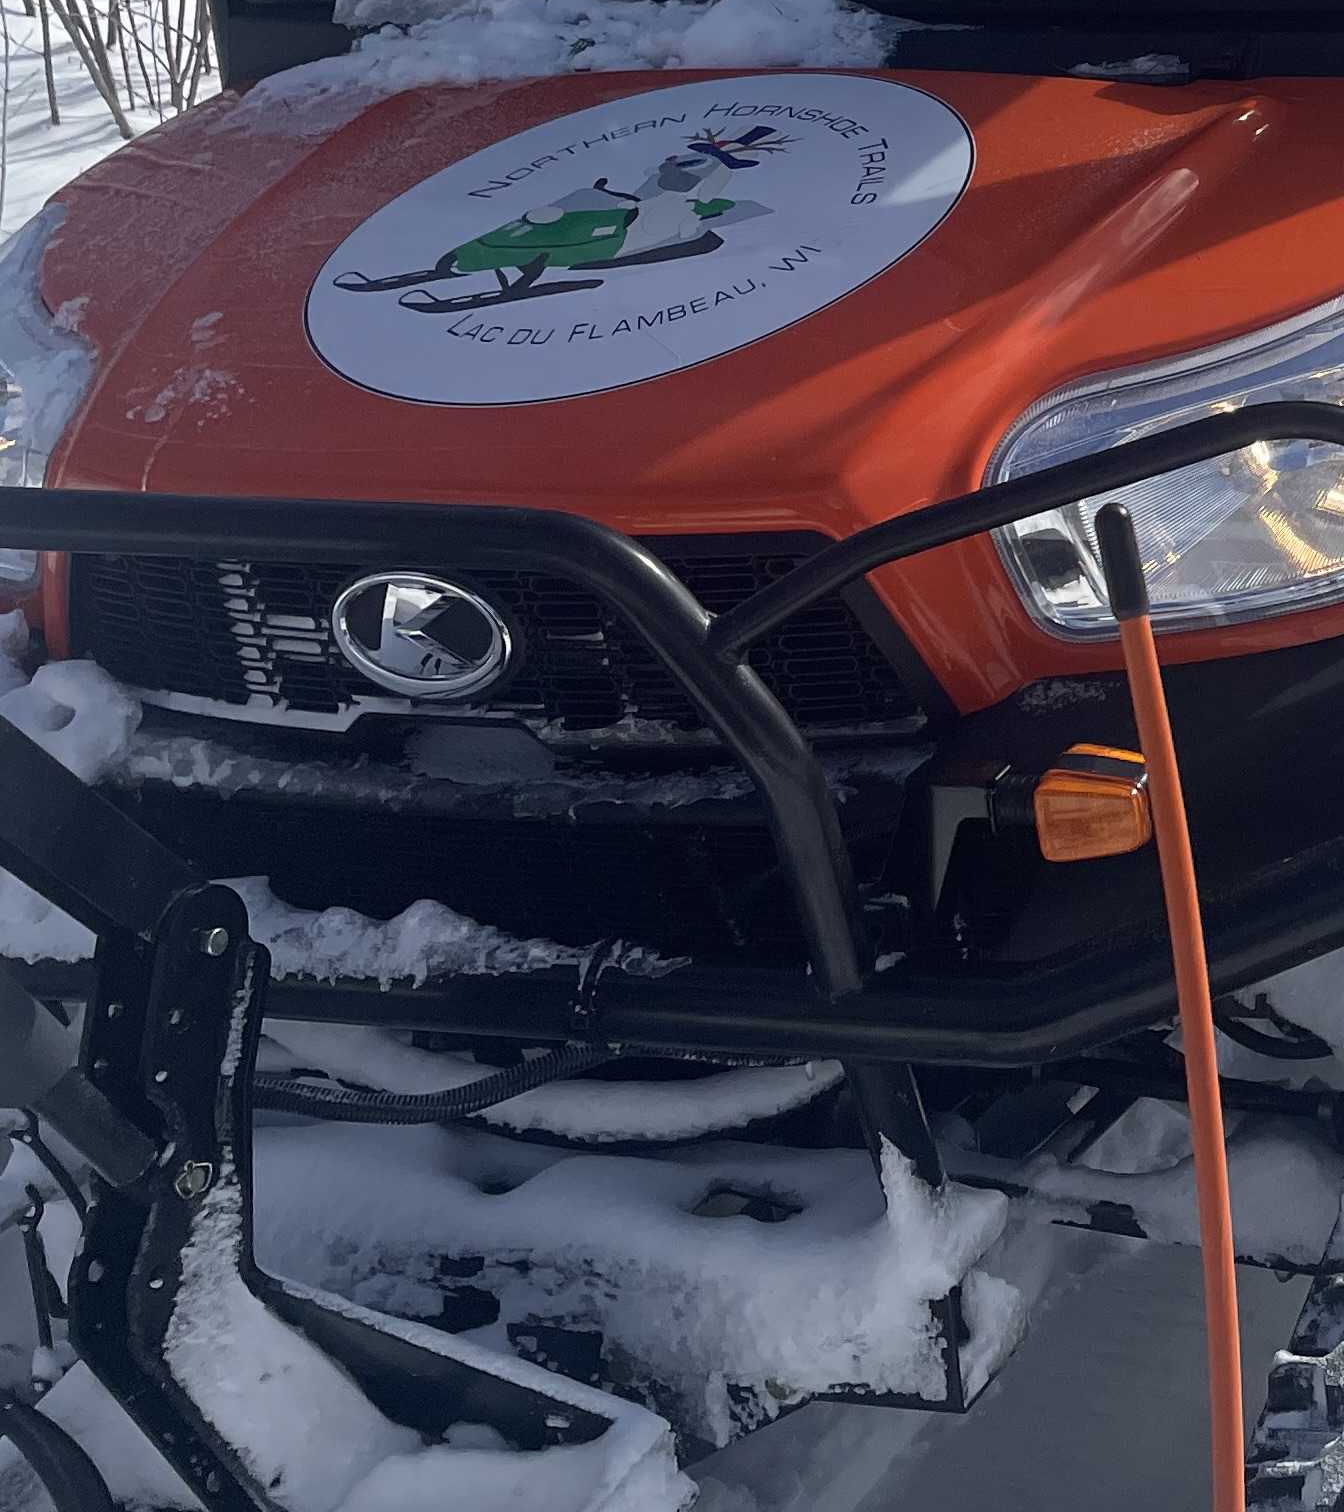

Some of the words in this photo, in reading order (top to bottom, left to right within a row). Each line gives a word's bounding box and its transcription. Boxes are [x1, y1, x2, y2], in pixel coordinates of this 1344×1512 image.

[468, 113, 686, 198] NORTHERN
[703, 102, 869, 139] HORNSHOE
[851, 138, 889, 205] TRAILS
[447, 313, 503, 343] LAC
[507, 328, 555, 346] DU
[769, 245, 822, 273] WI
